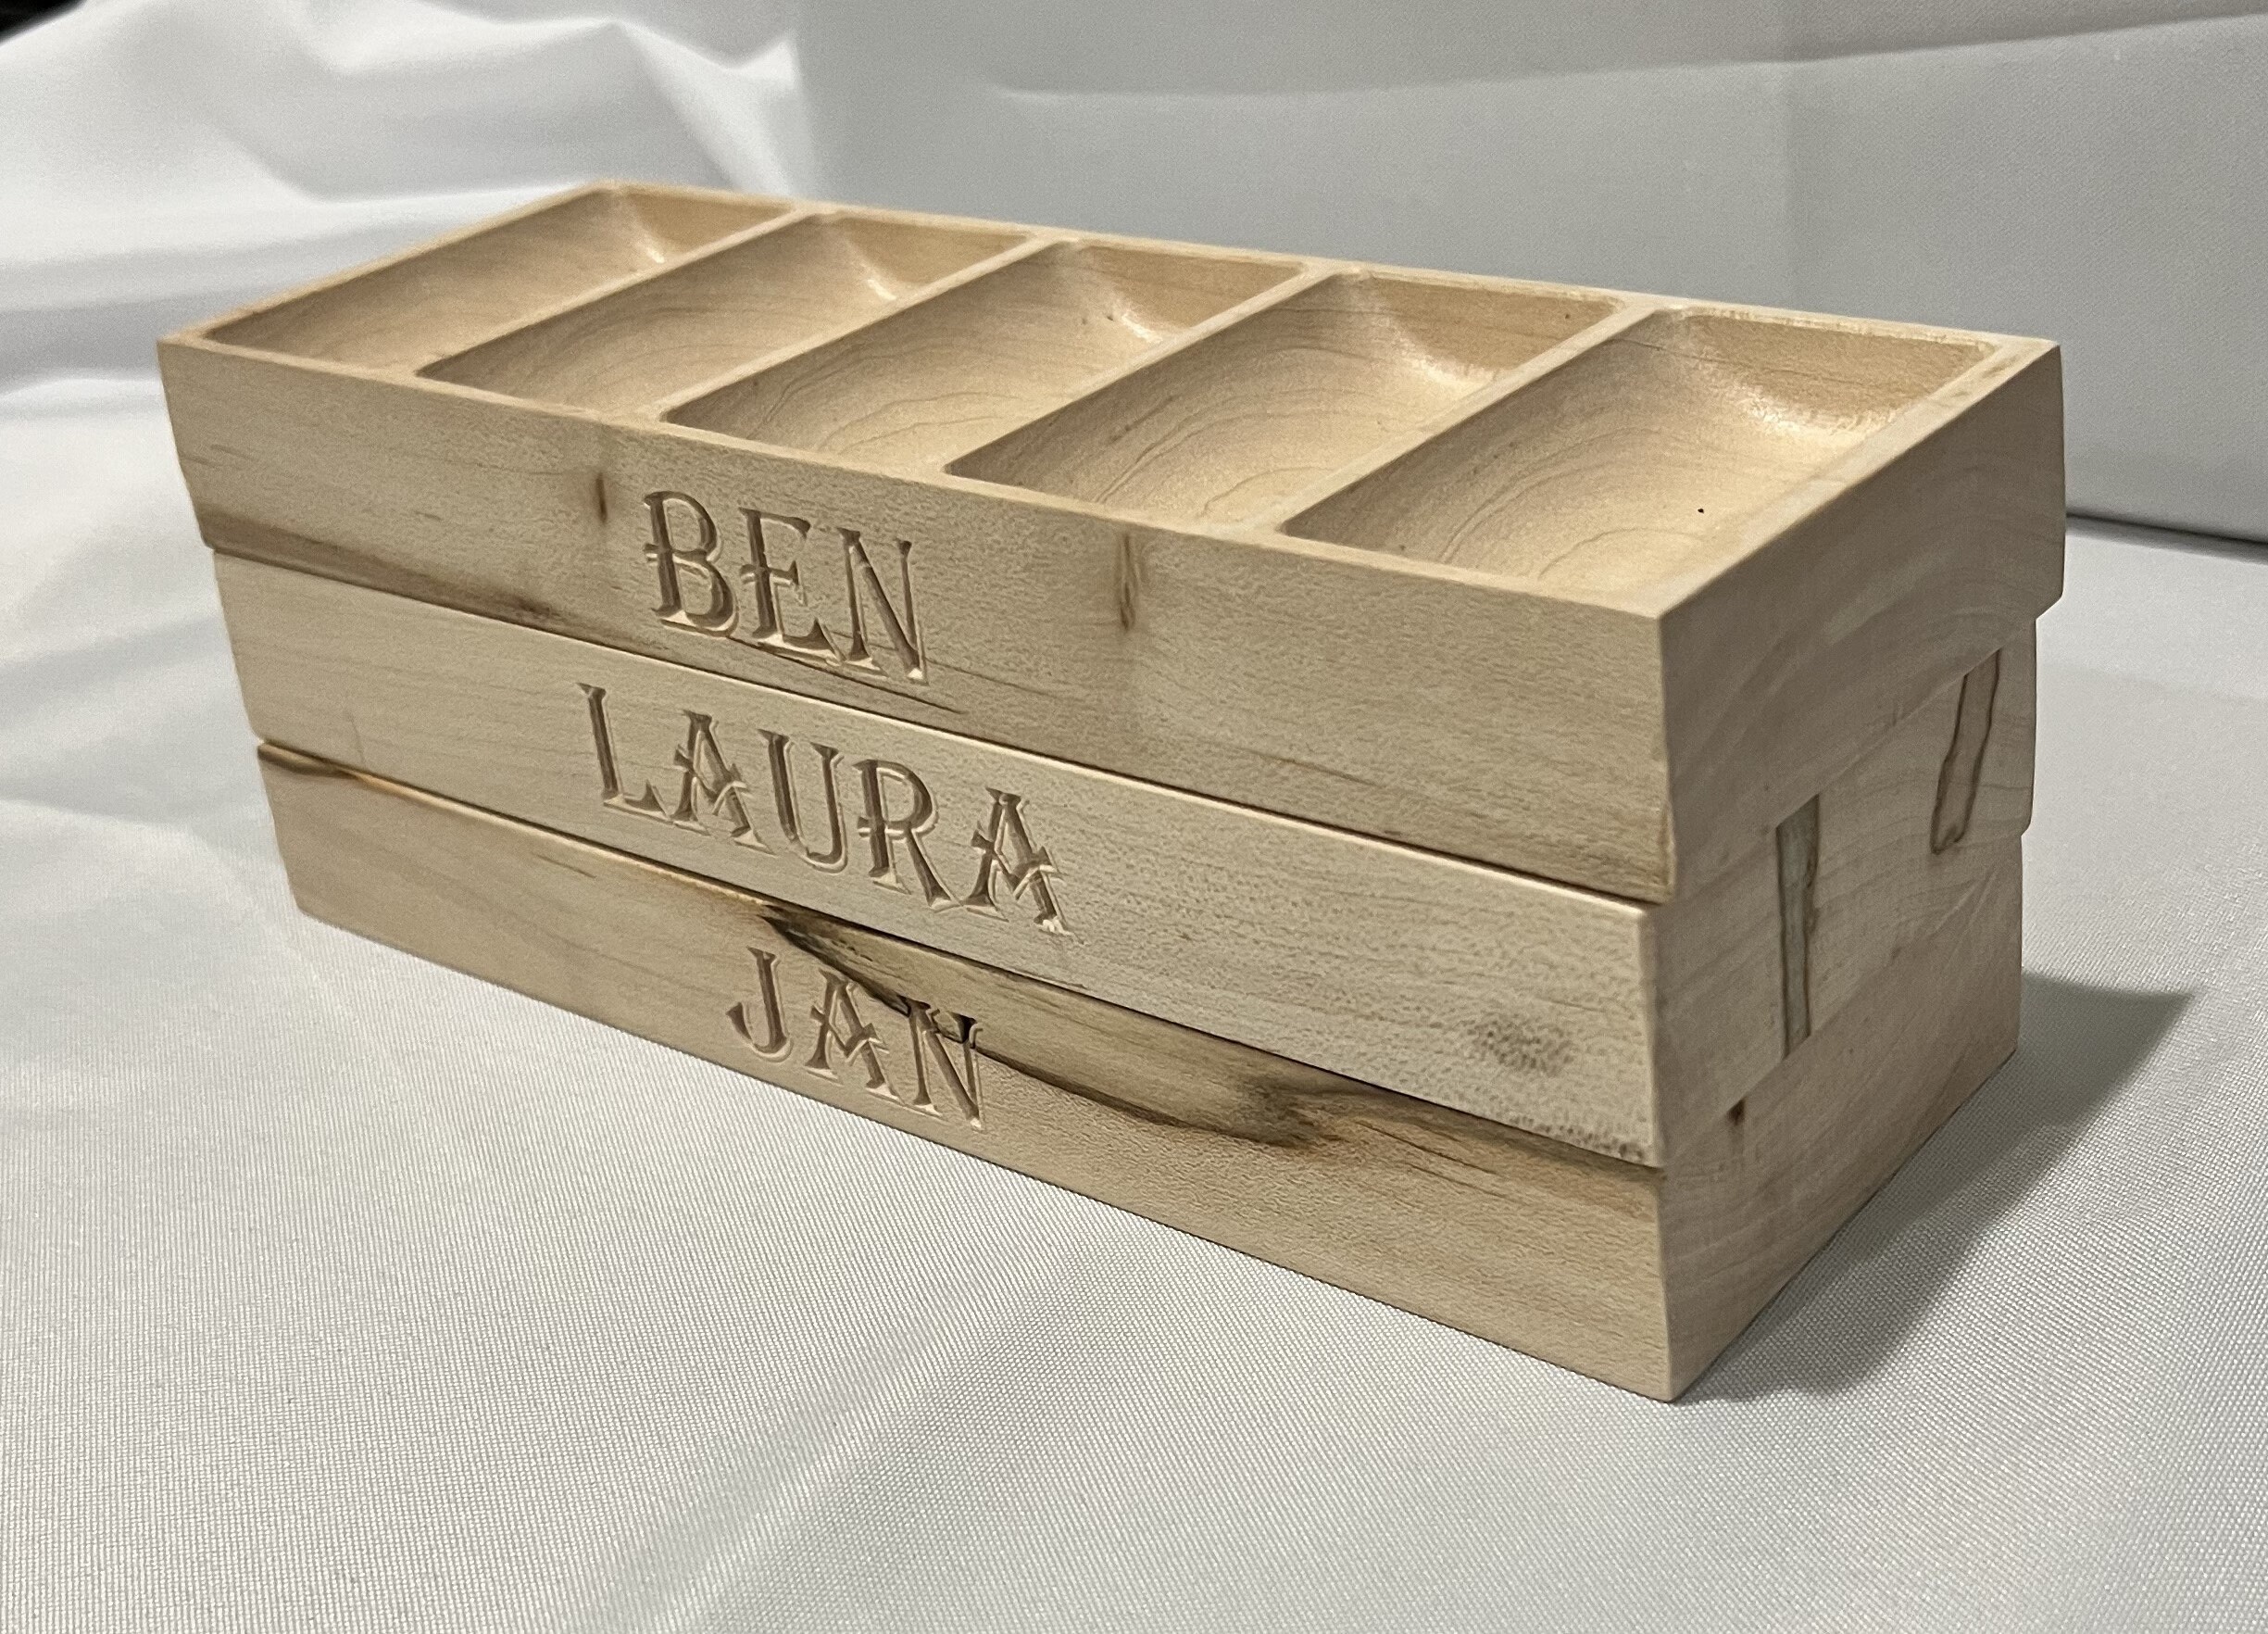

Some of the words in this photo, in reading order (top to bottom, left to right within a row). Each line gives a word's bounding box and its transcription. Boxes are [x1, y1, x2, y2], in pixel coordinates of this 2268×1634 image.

[643, 491, 928, 685] BEN
[576, 682, 1080, 940] LAURA
[725, 946, 985, 1130] JAN
